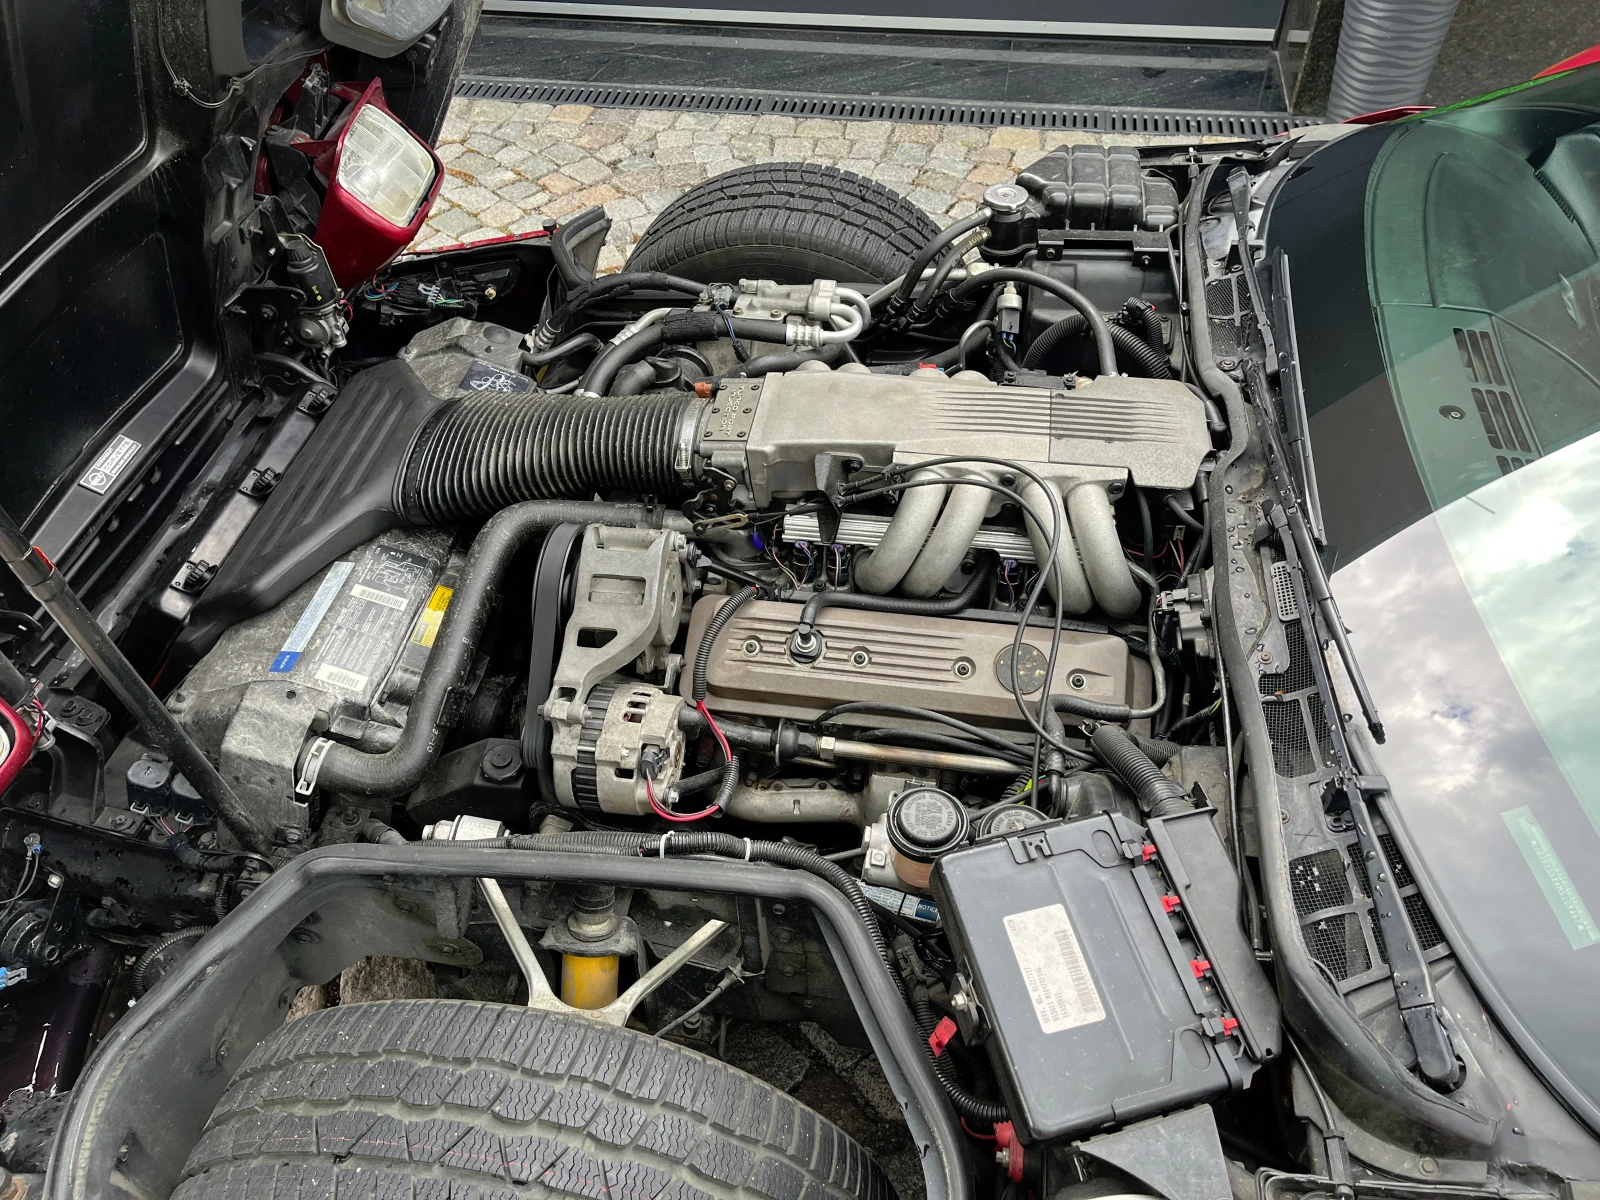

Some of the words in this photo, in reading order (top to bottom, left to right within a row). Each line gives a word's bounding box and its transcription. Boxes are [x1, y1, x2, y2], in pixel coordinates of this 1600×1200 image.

[719, 390, 736, 431] INJECTION
[725, 414, 735, 437] PORT
[104, 441, 130, 470] CORVETTE
[279, 654, 291, 669] NOTICE
